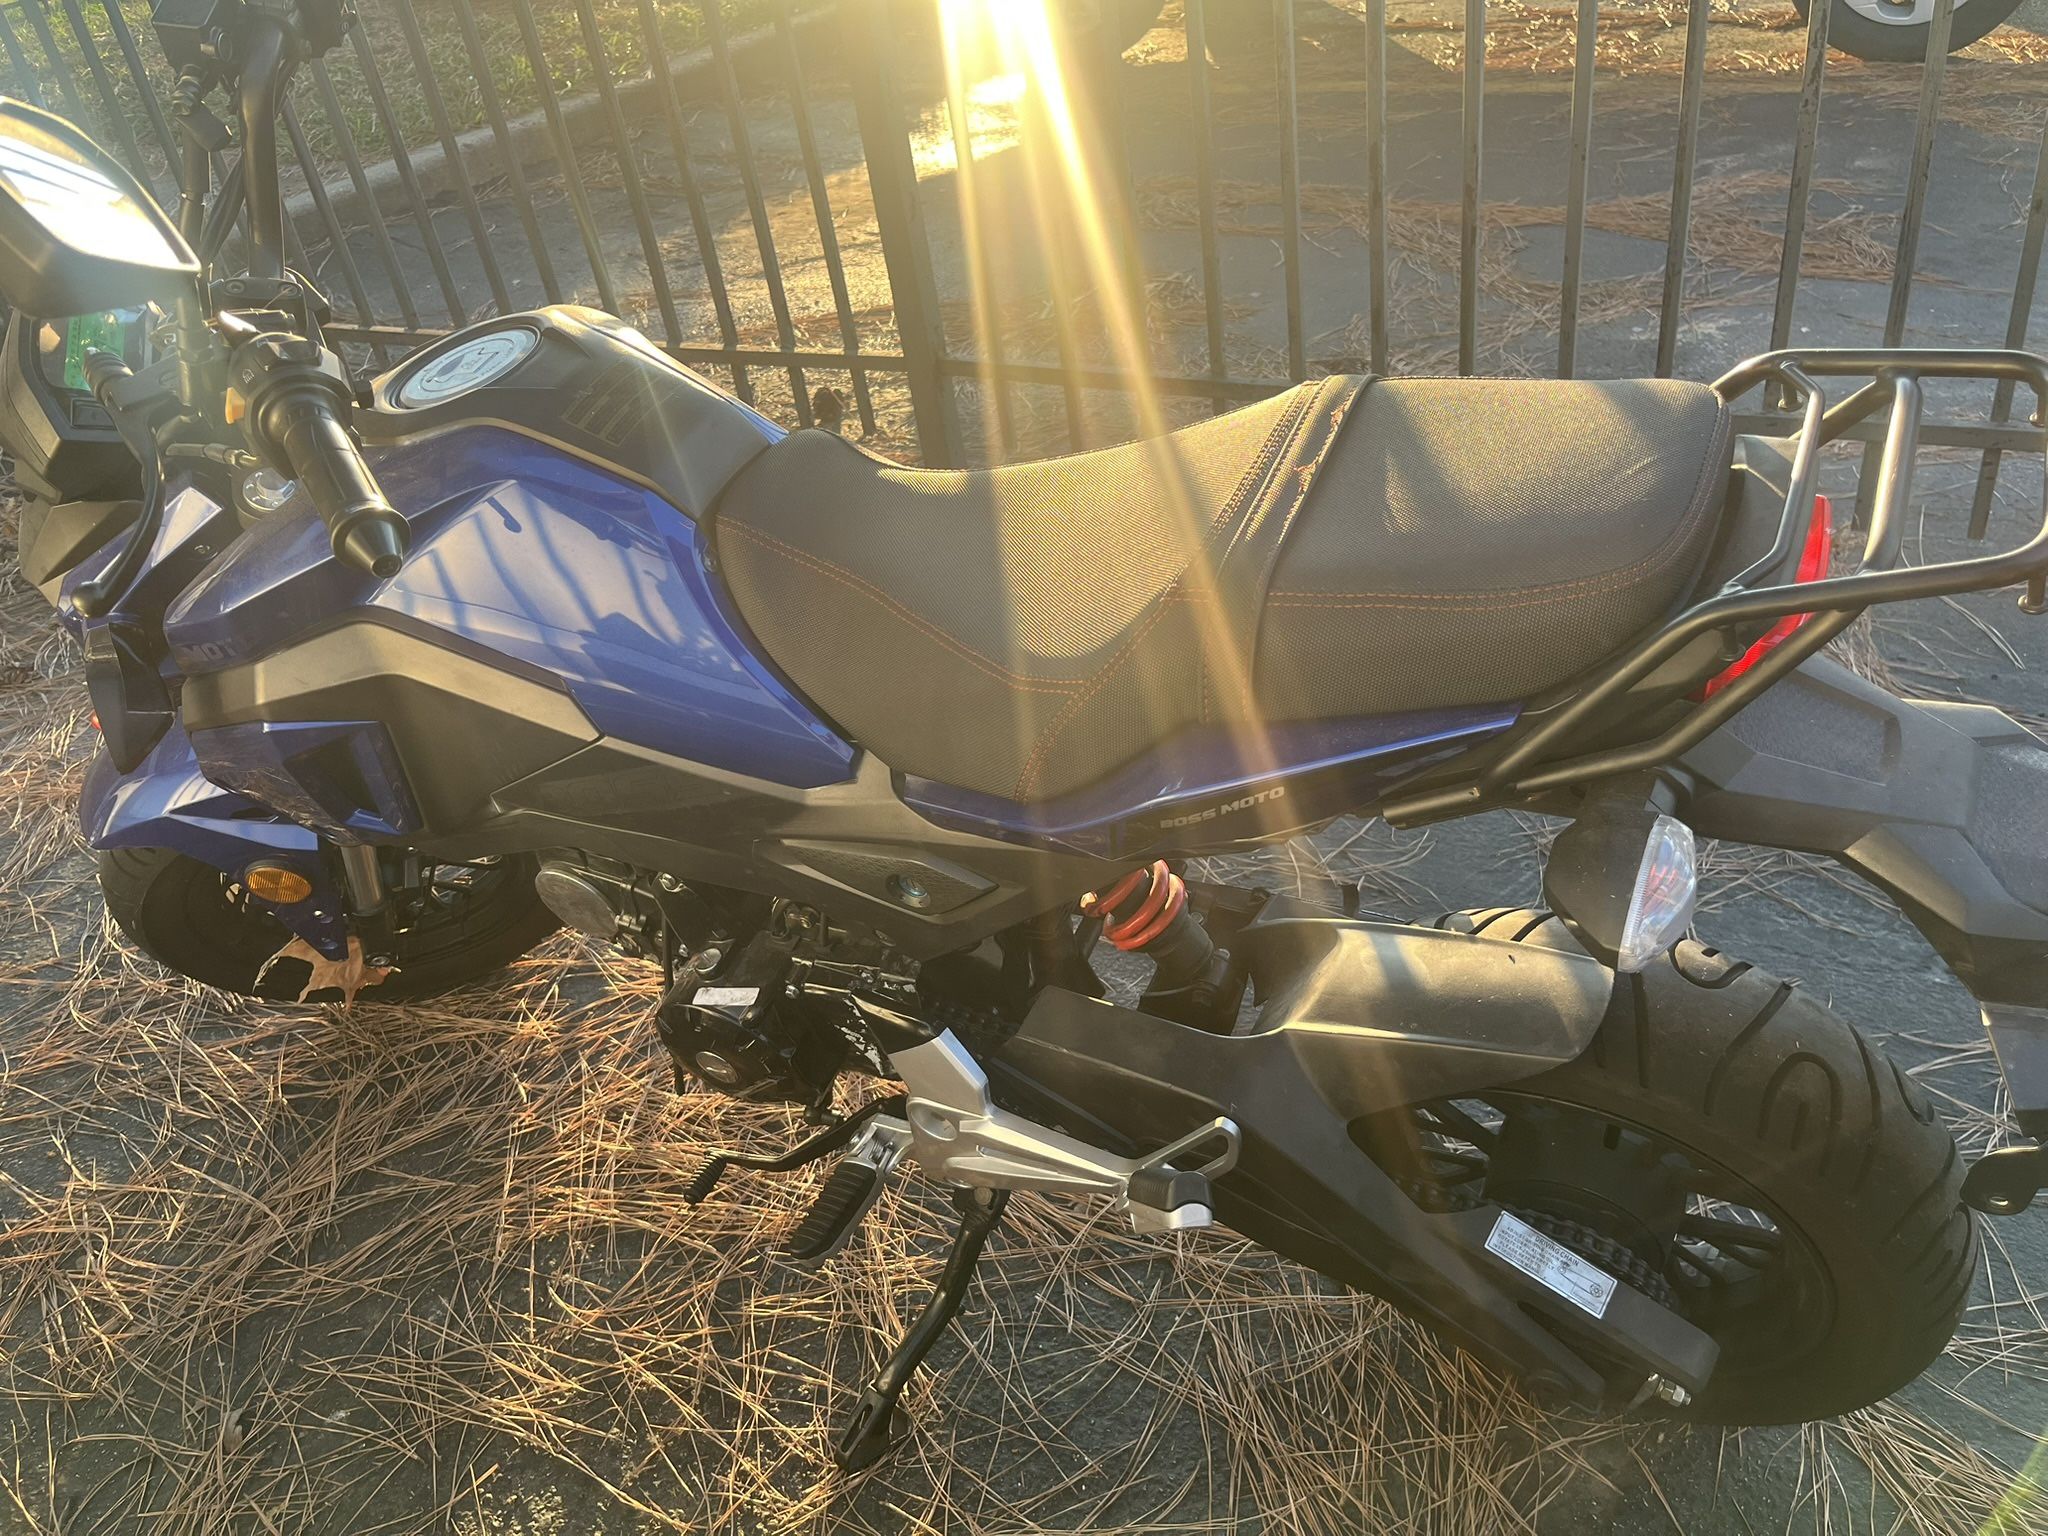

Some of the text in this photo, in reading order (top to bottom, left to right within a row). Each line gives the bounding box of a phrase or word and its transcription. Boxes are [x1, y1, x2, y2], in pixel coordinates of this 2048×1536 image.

[1160, 786, 1285, 829] BOSS MOTO
[1535, 1235, 1580, 1267] DRIVING CHAIN
